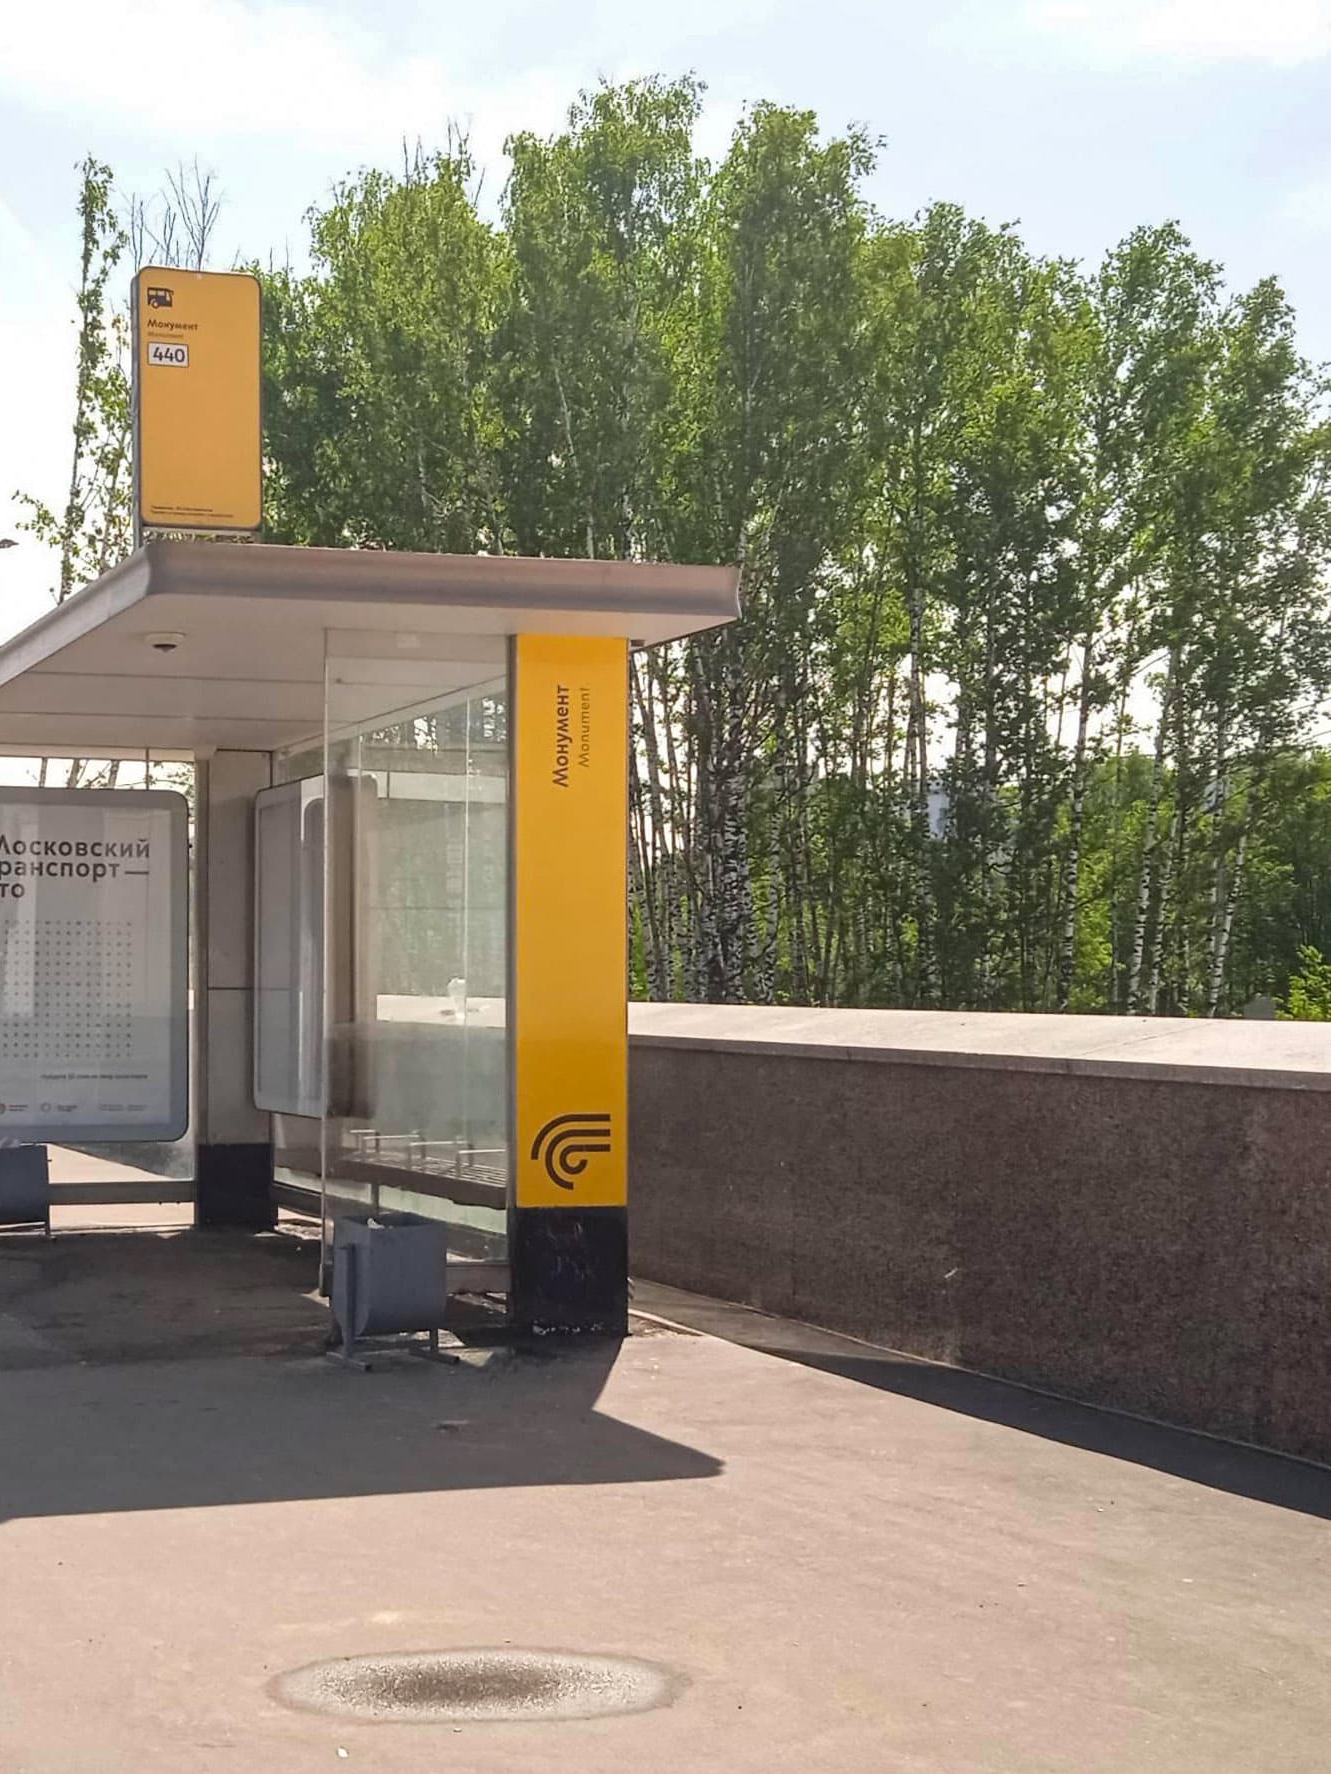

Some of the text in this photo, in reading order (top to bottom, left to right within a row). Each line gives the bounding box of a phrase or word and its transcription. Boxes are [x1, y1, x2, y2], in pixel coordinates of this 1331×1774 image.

[147, 319, 198, 331] Монумент
[153, 346, 186, 363] 440
[552, 684, 573, 788] Монумент
[578, 686, 590, 768] Monument
